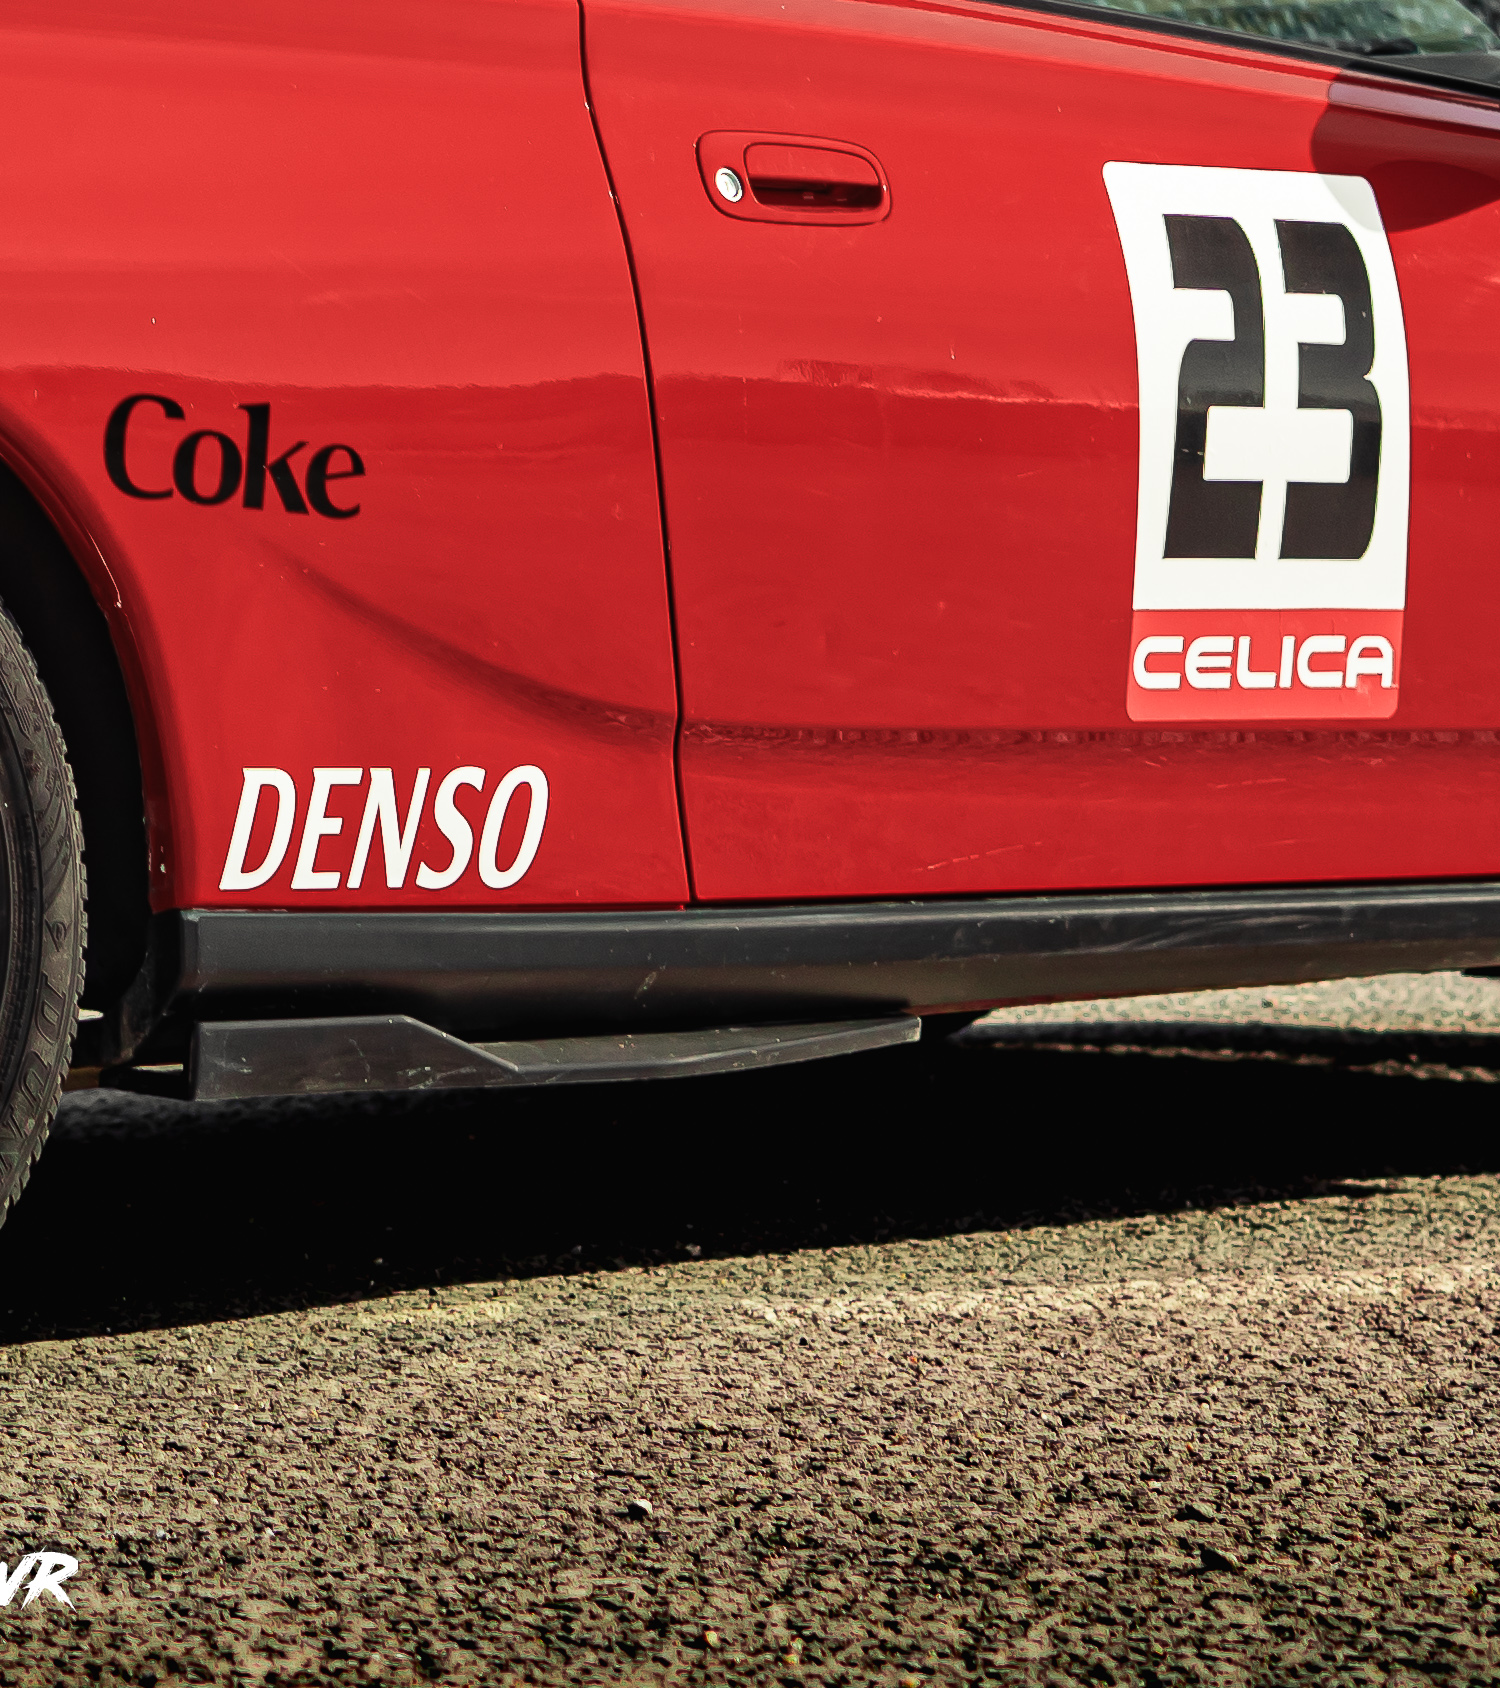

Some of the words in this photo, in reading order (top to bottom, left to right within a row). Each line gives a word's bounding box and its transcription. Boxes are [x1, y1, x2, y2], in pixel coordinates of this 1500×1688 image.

[1161, 213, 1383, 561] 23
[103, 393, 367, 520] Coke
[1132, 635, 1398, 691] CELICA
[218, 765, 549, 891] DENSO
